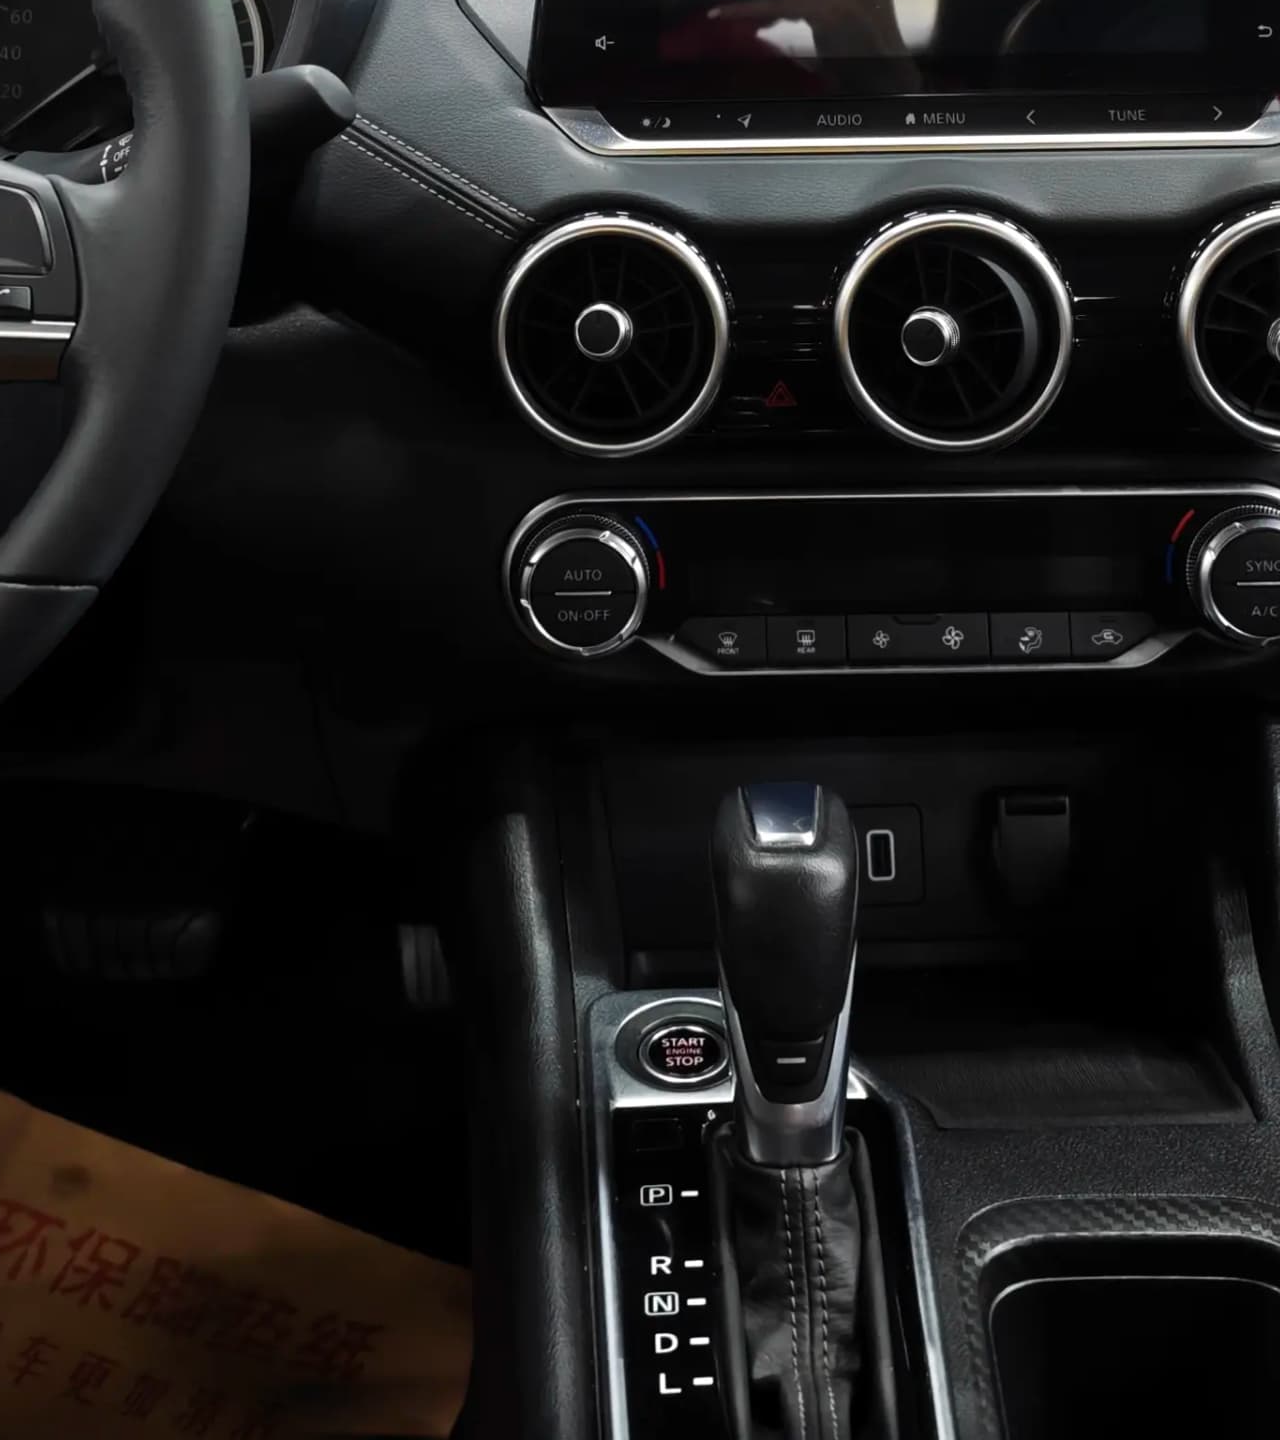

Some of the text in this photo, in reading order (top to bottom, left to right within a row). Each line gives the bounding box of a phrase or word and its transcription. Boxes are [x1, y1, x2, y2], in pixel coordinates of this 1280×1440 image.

[9, 9, 33, 25] 60
[0, 45, 22, 61] 40
[0, 83, 22, 99] 20
[816, 112, 863, 127] AUDIO
[922, 112, 967, 126] MENU
[1107, 108, 1147, 123] TUNE
[113, 146, 131, 162] OFF
[563, 568, 603, 582] AUTO
[1250, 604, 1280, 620] A/C
[716, 647, 740, 655] FRONT
[661, 1036, 706, 1048] START
[665, 1047, 703, 1056] ENGINE
[665, 1055, 704, 1068] STOP
[647, 1188, 666, 1203] P
[651, 1255, 672, 1275] R
[652, 1294, 672, 1312] N
[655, 1332, 679, 1354] D
[658, 1372, 682, 1395] L
